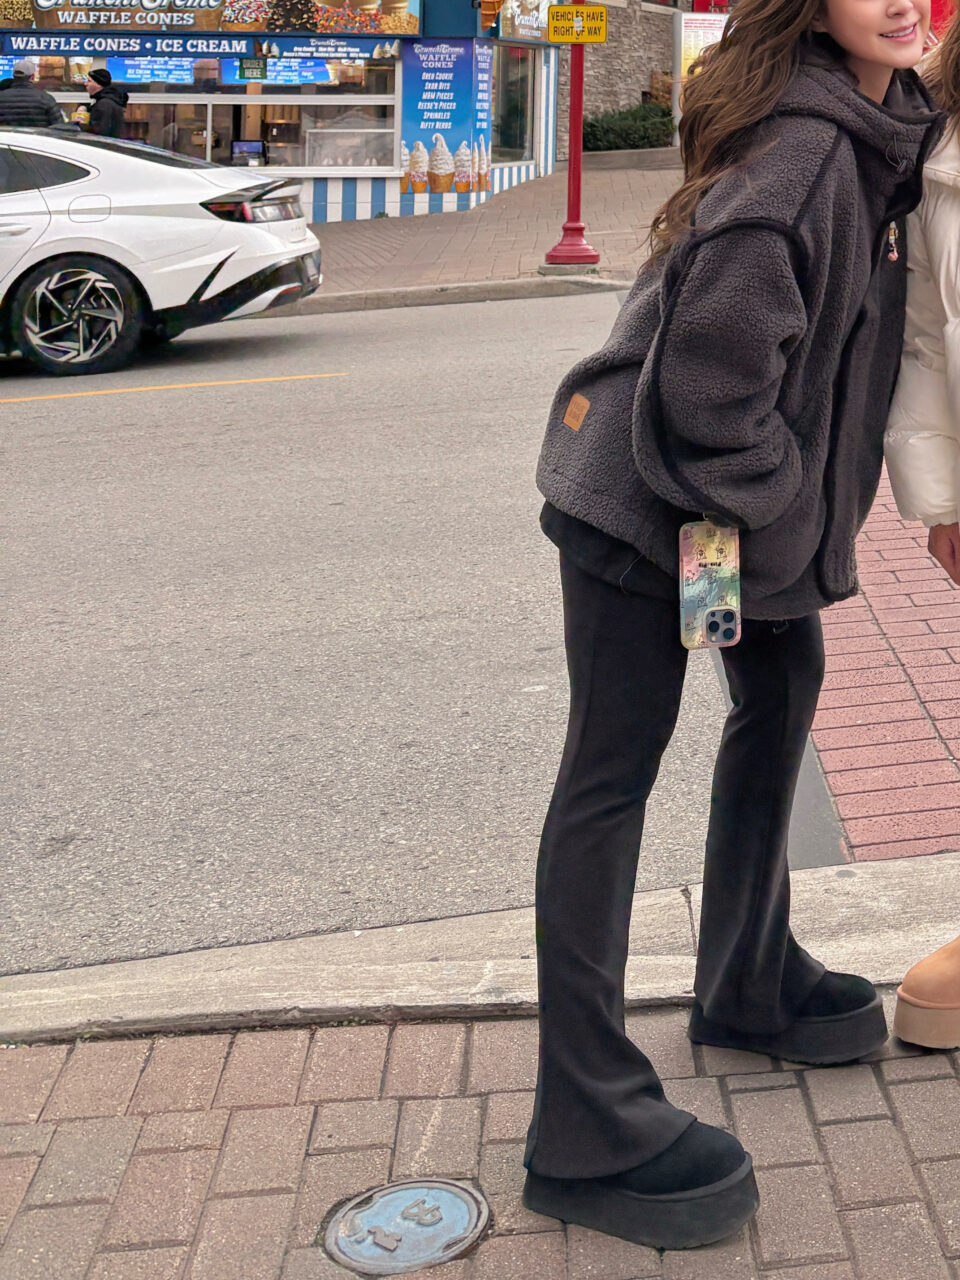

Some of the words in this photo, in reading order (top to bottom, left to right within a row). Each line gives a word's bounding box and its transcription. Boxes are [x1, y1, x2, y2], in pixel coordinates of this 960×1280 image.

[57, 11, 131, 25] WAFFLE
[134, 12, 195, 26] CONES
[586, 11, 604, 22] HAVE
[553, 26, 574, 36] RIGHT
[587, 26, 601, 36] WAY
[11, 37, 80, 51] WAFFLE
[84, 37, 141, 52] CONES
[156, 38, 183, 52] ICE
[186, 39, 247, 54] CREAM
[419, 54, 457, 62] WAFFLE
[422, 61, 454, 69] CONES
